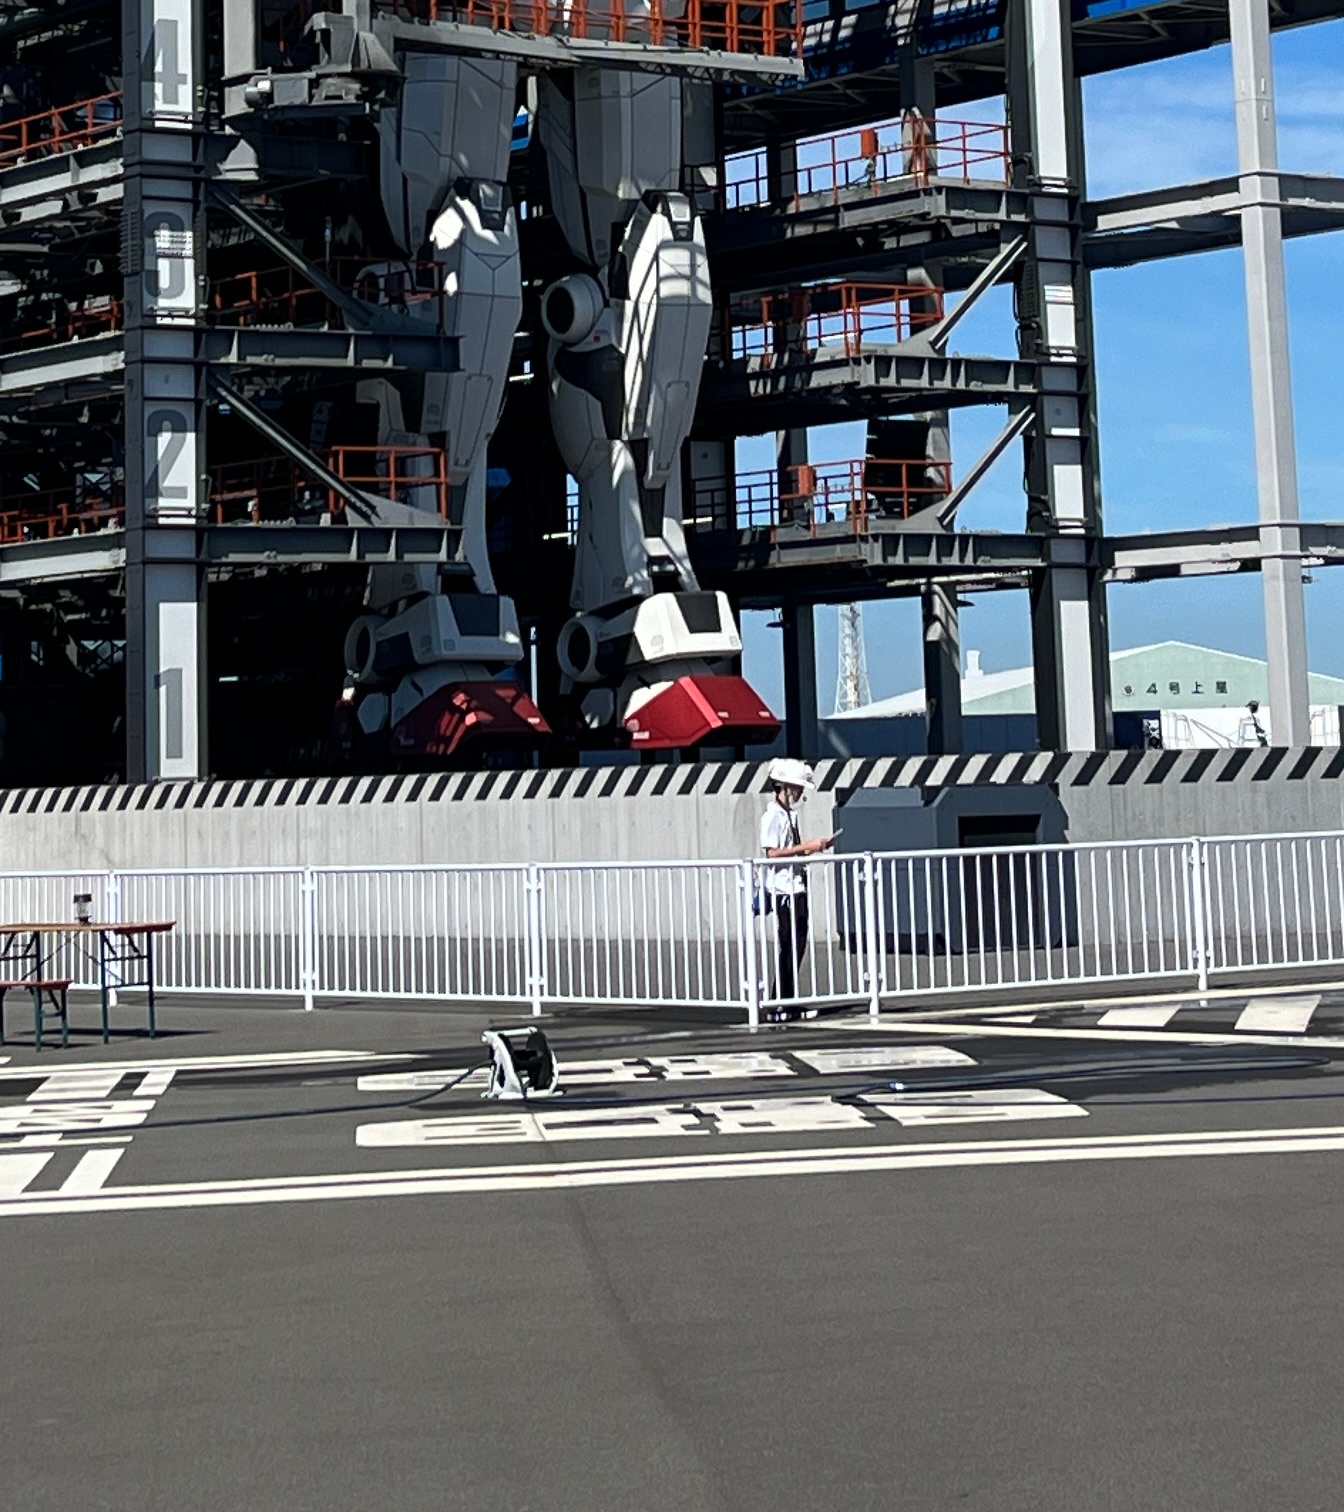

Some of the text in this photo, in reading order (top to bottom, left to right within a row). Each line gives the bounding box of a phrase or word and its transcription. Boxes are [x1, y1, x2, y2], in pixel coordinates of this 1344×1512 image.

[140, 18, 189, 105] 4
[143, 409, 189, 499] 2
[153, 667, 183, 759] 1
